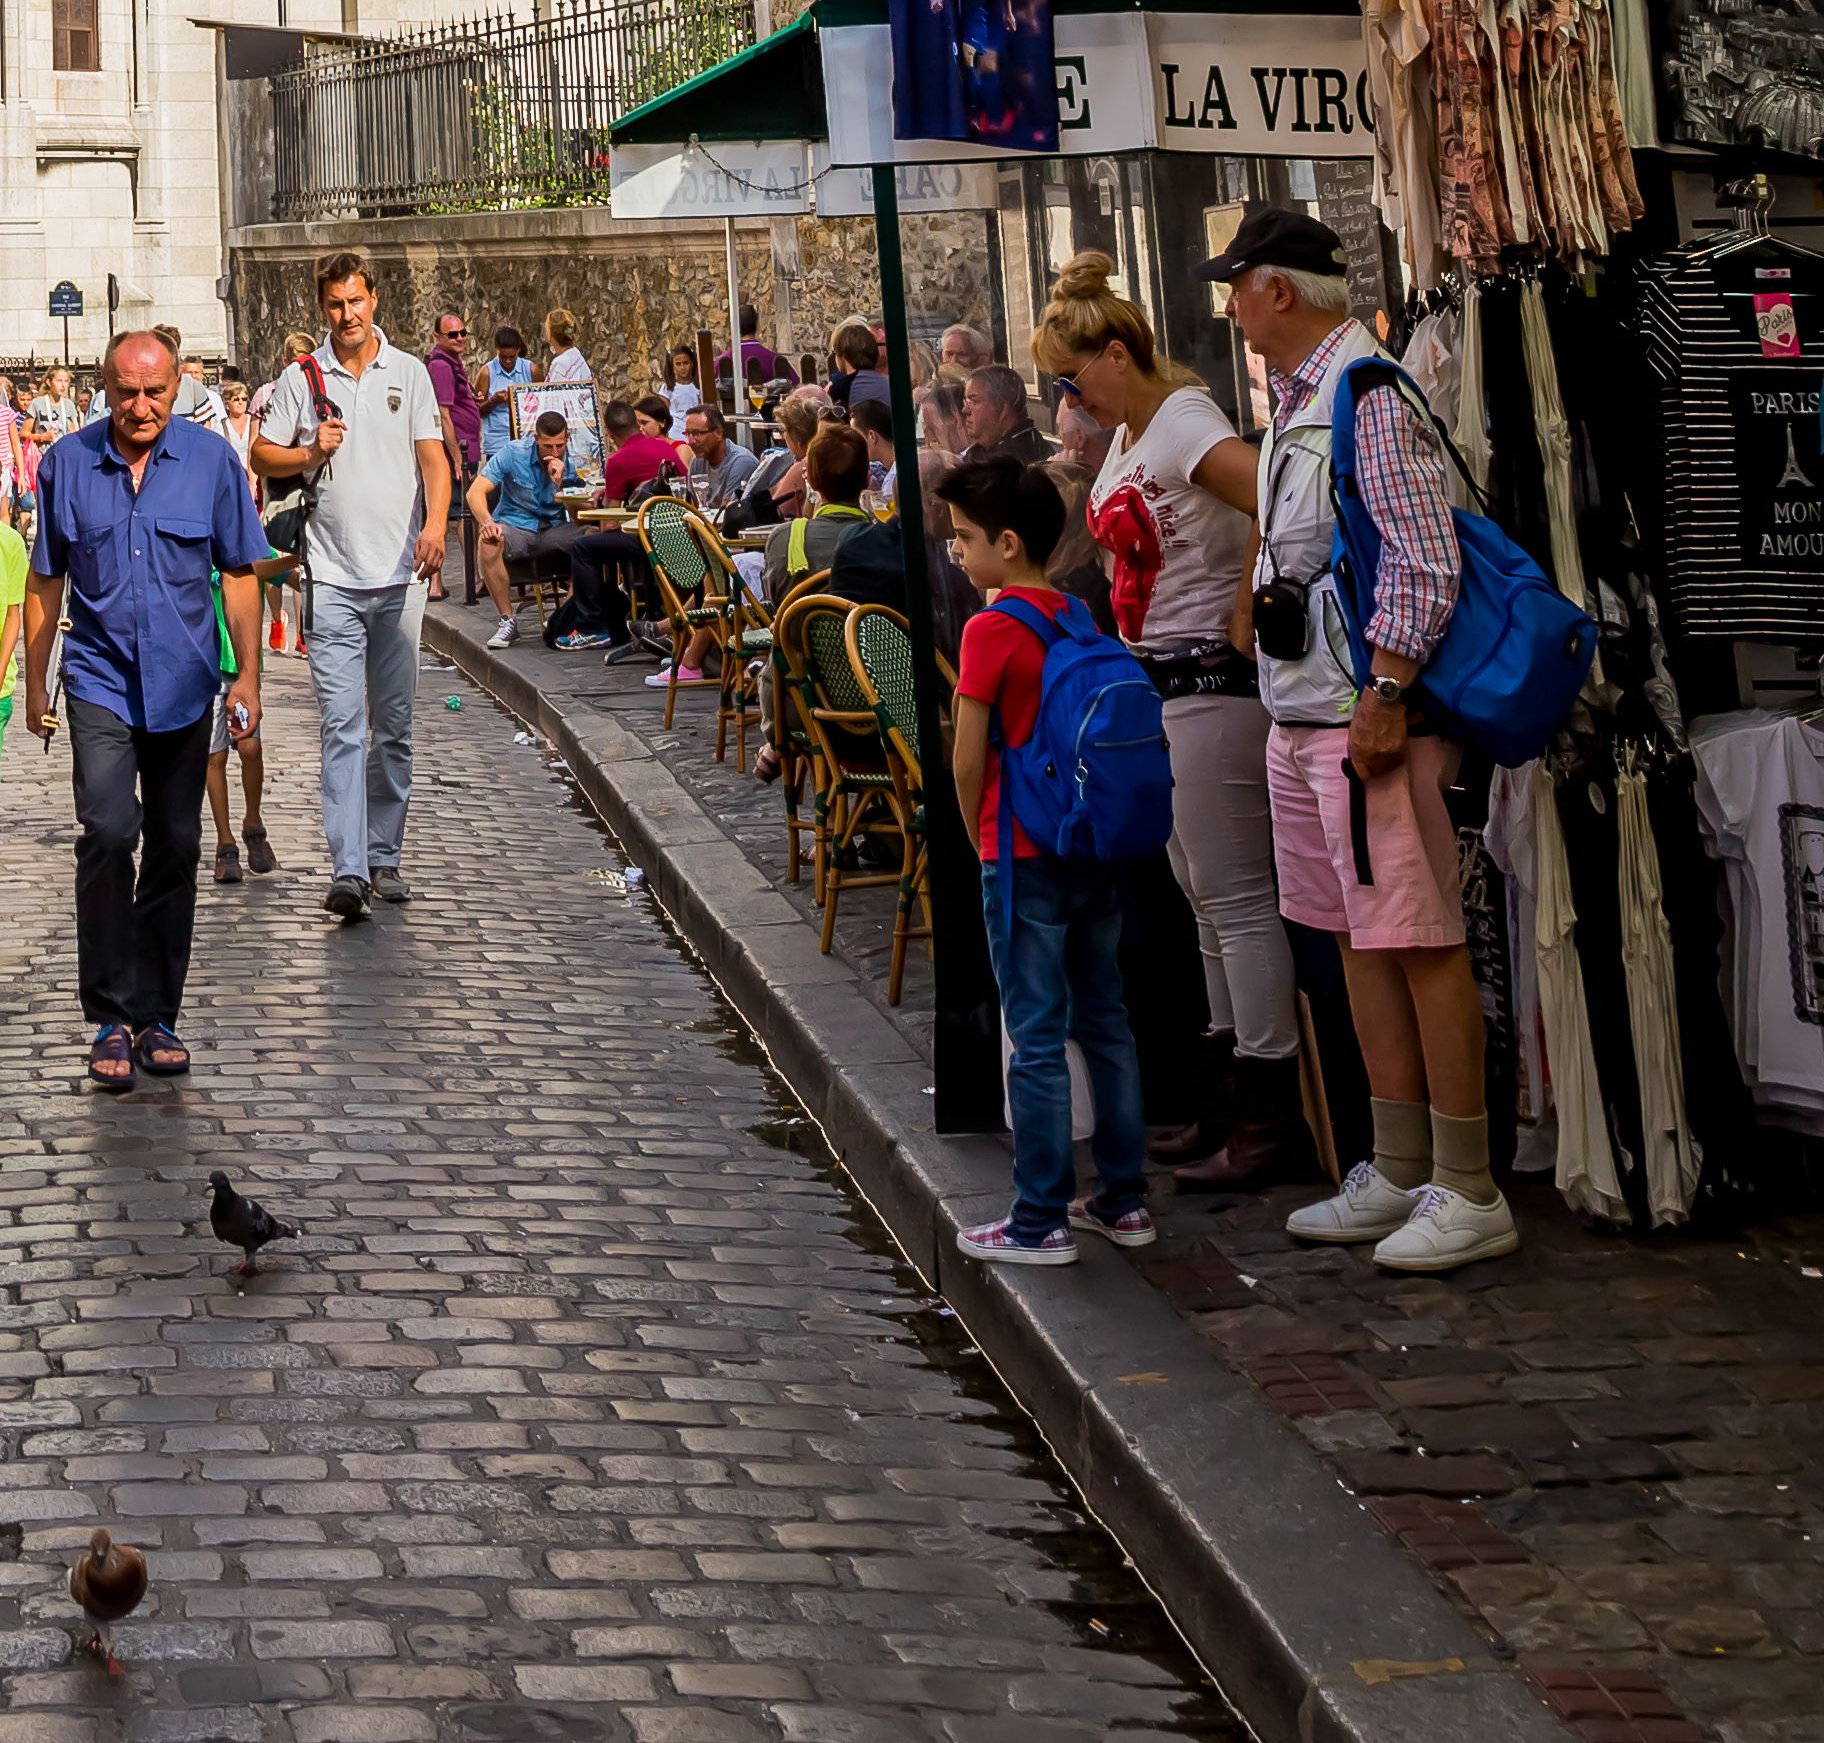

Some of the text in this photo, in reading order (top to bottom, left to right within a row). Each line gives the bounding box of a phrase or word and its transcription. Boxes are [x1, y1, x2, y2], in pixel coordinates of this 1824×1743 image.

[1161, 63, 1238, 132] LA
[1756, 307, 1794, 337] Paris
[1751, 392, 1821, 414] PARIS
[1774, 501, 1822, 524] MON
